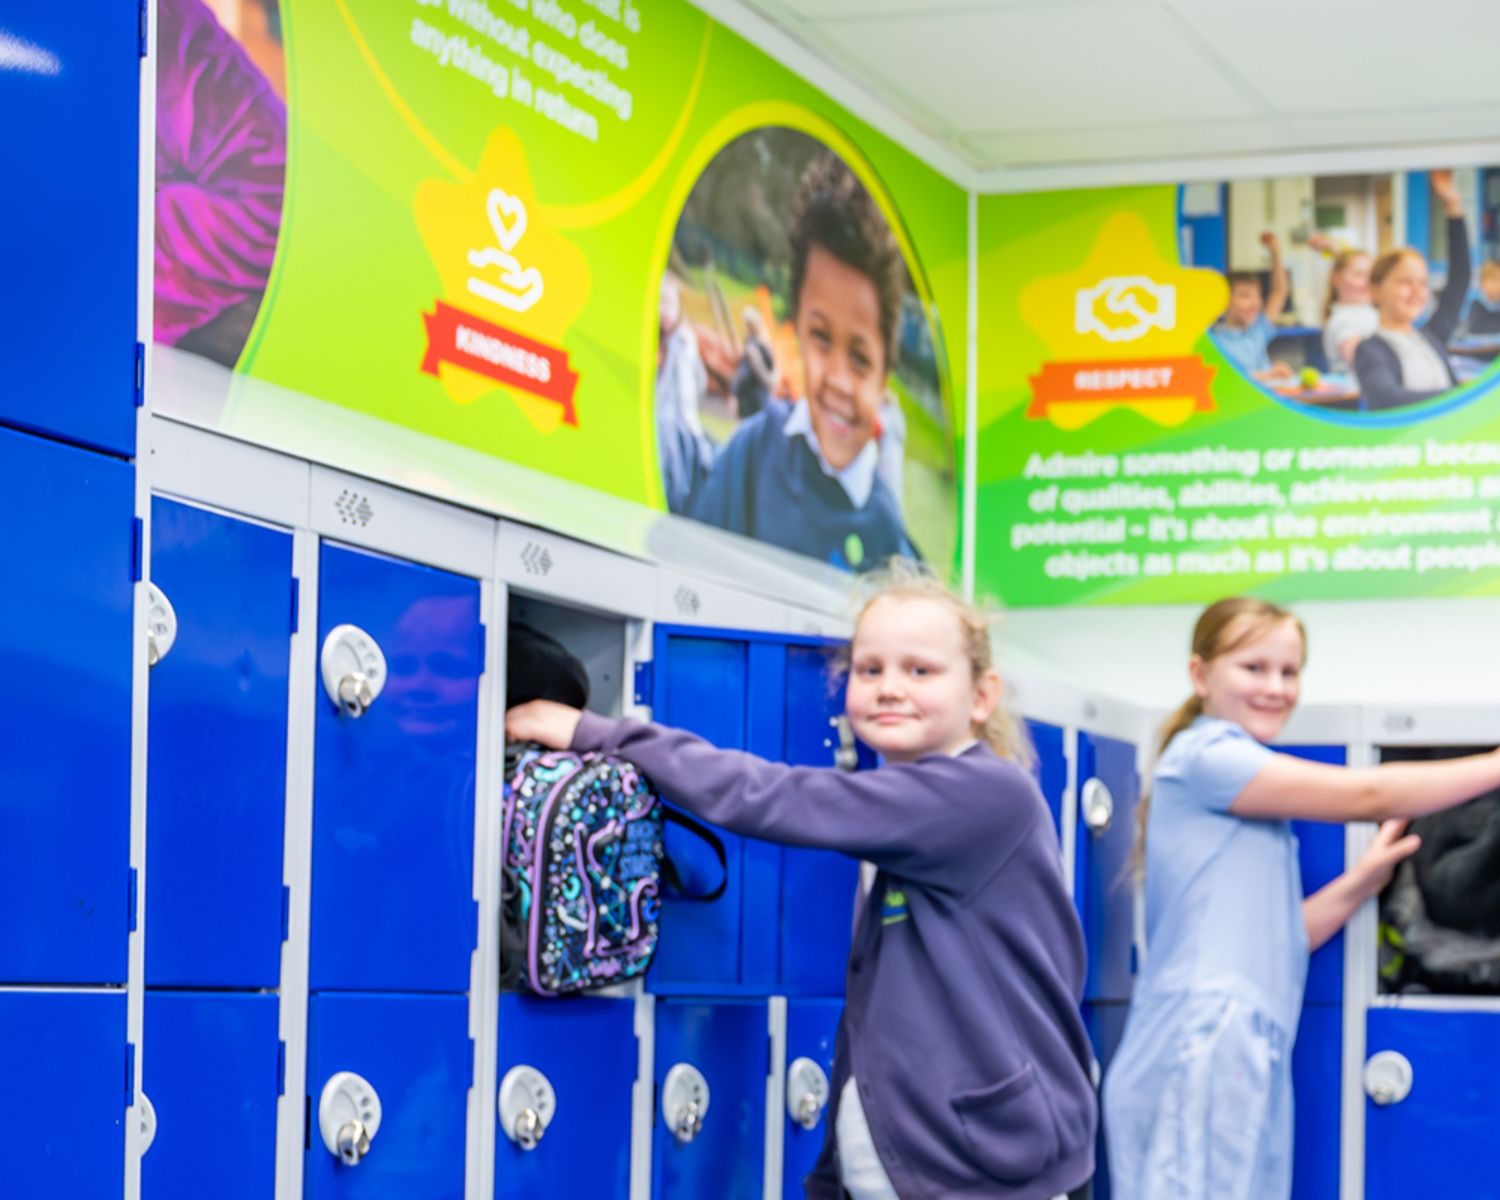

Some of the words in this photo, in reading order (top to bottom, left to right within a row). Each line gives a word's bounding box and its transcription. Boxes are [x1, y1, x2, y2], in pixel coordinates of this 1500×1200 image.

[447, 0, 530, 58] without
[532, 41, 632, 121] expecting
[579, 20, 628, 70] does
[410, 17, 508, 98] anything
[511, 66, 533, 108] in
[535, 87, 598, 143] return
[455, 324, 551, 383] KINDNESS
[1074, 366, 1173, 390] RESPECT
[1023, 450, 1118, 480] Admire
[1122, 445, 1260, 477] something
[1263, 448, 1294, 471] or
[1298, 444, 1420, 470] someone
[1028, 484, 1059, 513] of
[1061, 483, 1175, 515] qualities,
[1179, 479, 1286, 507] abilities,
[1290, 474, 1473, 504] achievements
[1010, 516, 1126, 550] potential
[1191, 512, 1268, 541] about
[1273, 512, 1317, 538] the
[1321, 507, 1491, 537] environment
[1044, 549, 1139, 582] objects
[1143, 553, 1172, 576] as
[1175, 545, 1250, 574] much
[1255, 551, 1284, 573] as
[1332, 544, 1411, 571] about
